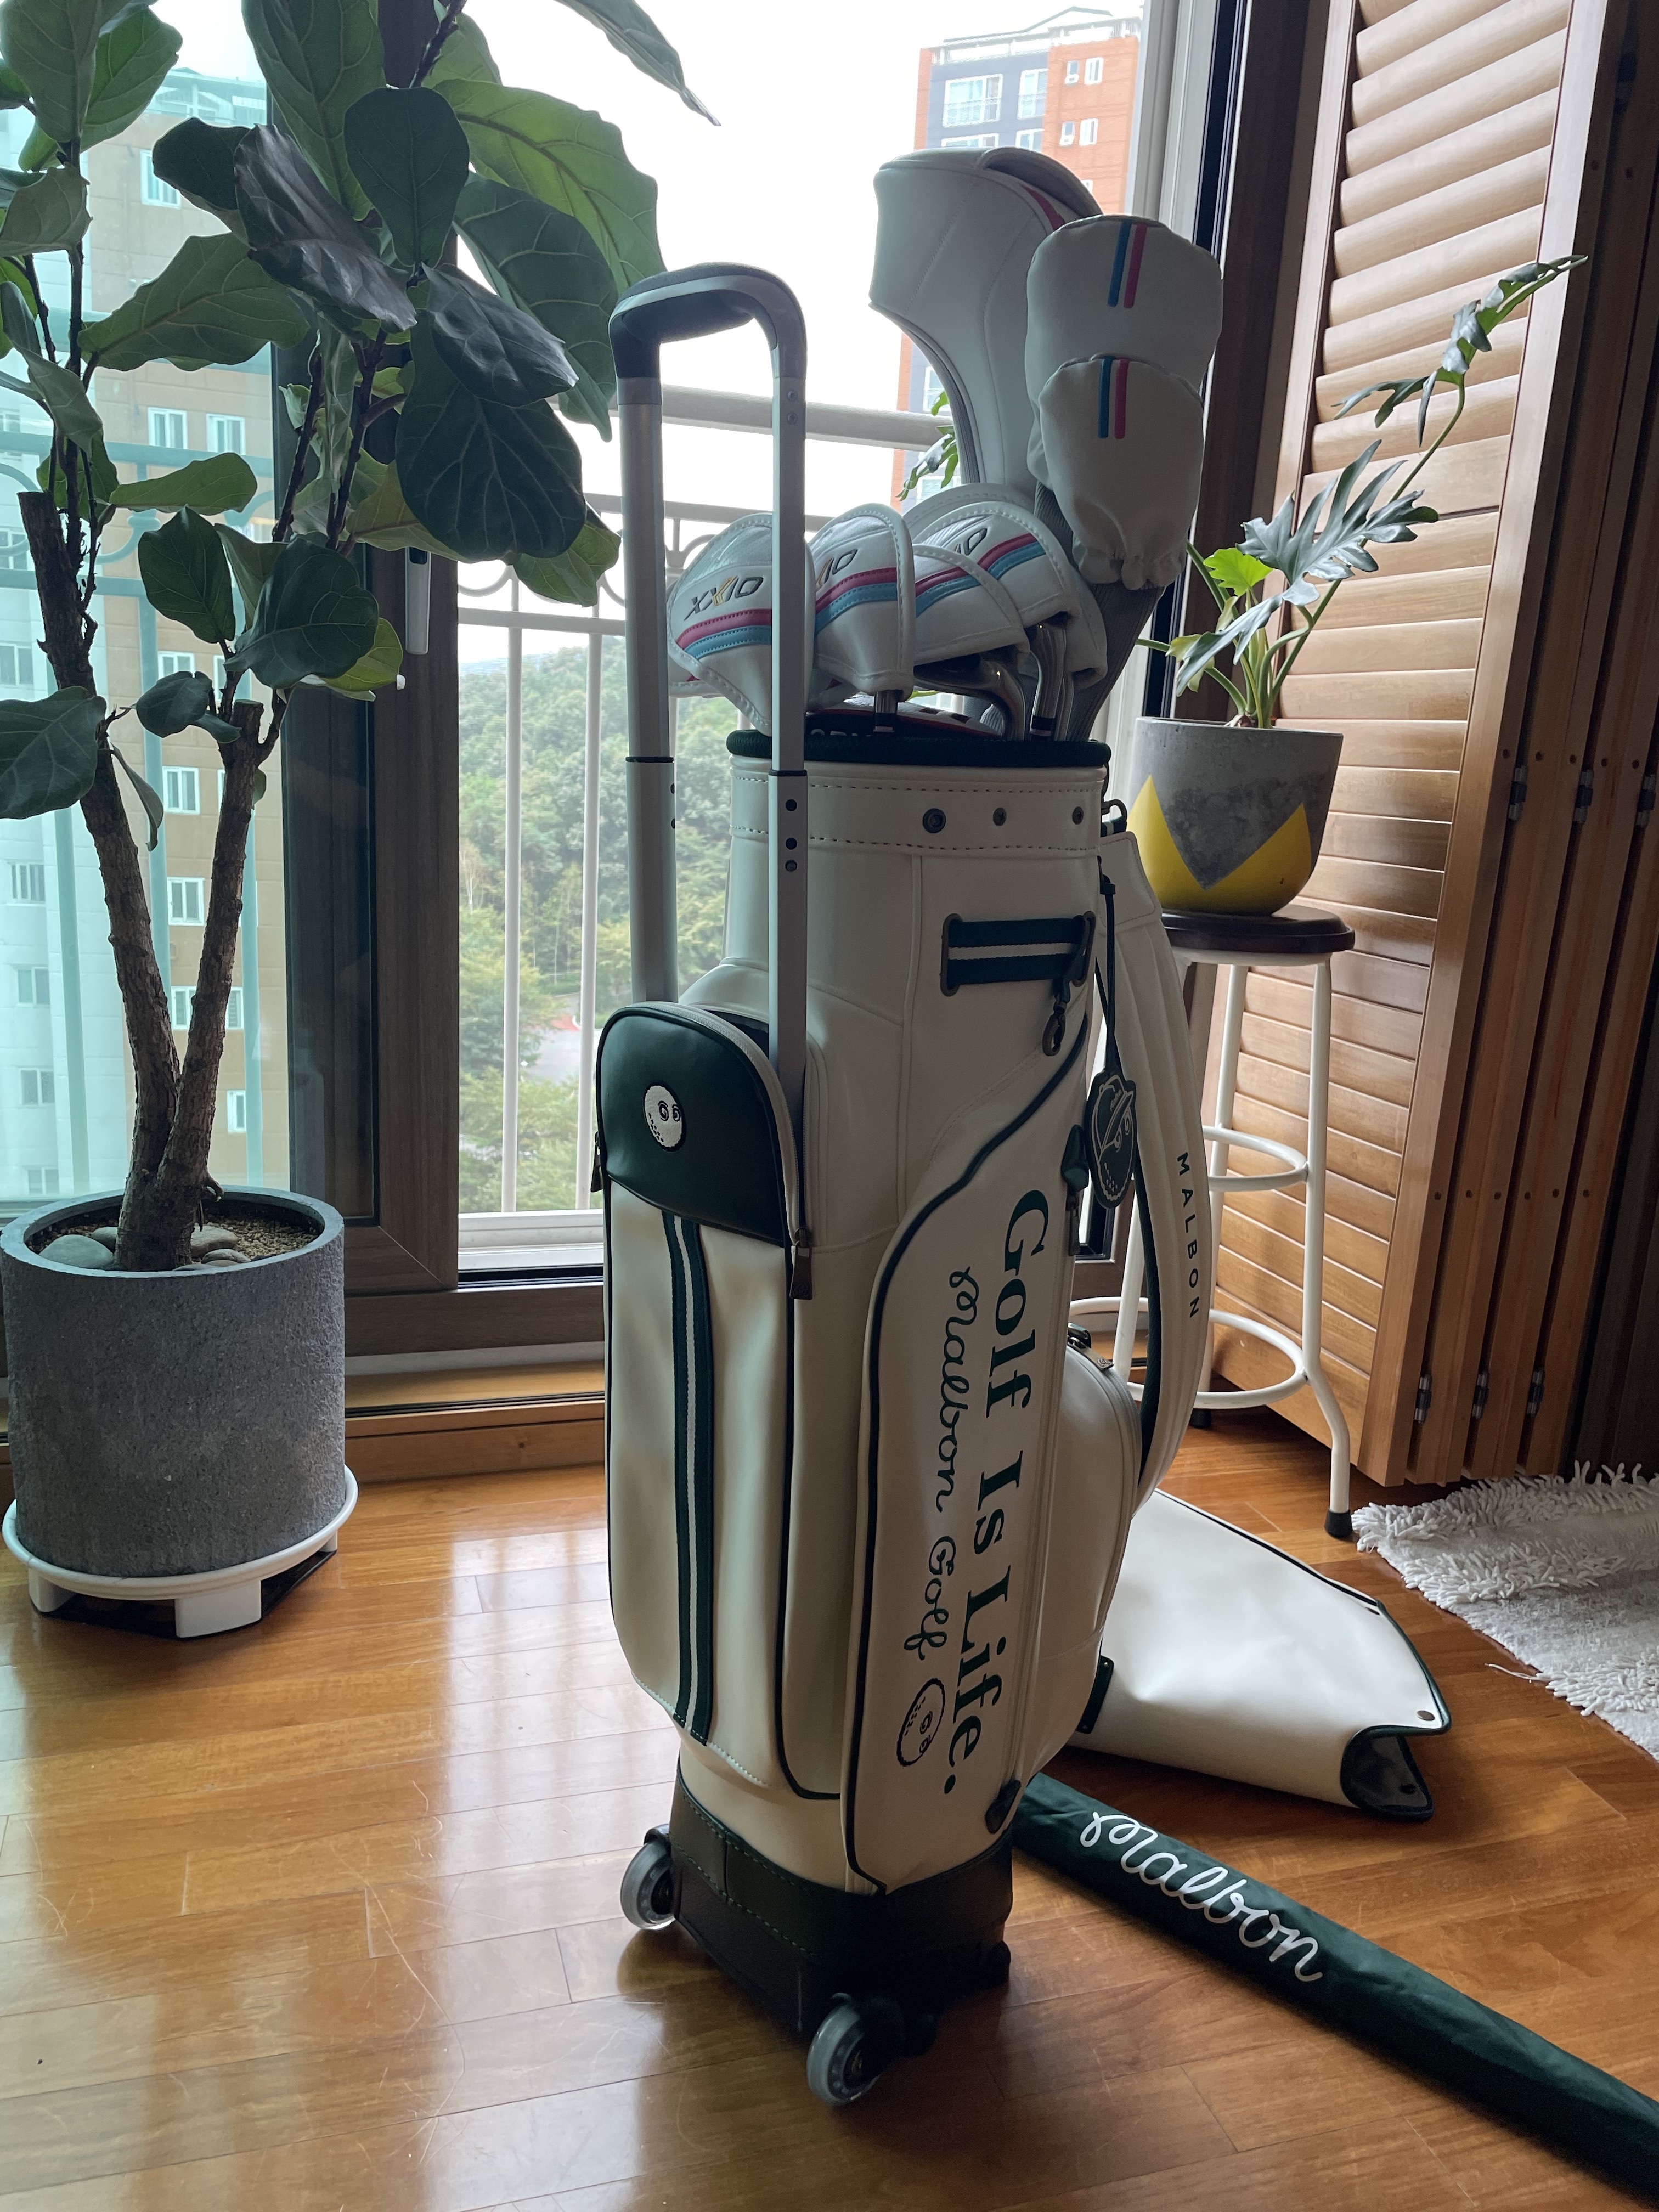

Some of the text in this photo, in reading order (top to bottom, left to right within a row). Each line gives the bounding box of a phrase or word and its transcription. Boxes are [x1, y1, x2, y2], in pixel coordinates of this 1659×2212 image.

[684, 575, 764, 621] XXIO
[1177, 1152, 1200, 1318] MALBON
[904, 1266, 979, 1661] Malbon Golf
[943, 1189, 1049, 1795] Golf Is Life.
[1079, 1811, 1323, 1982] Malbon
